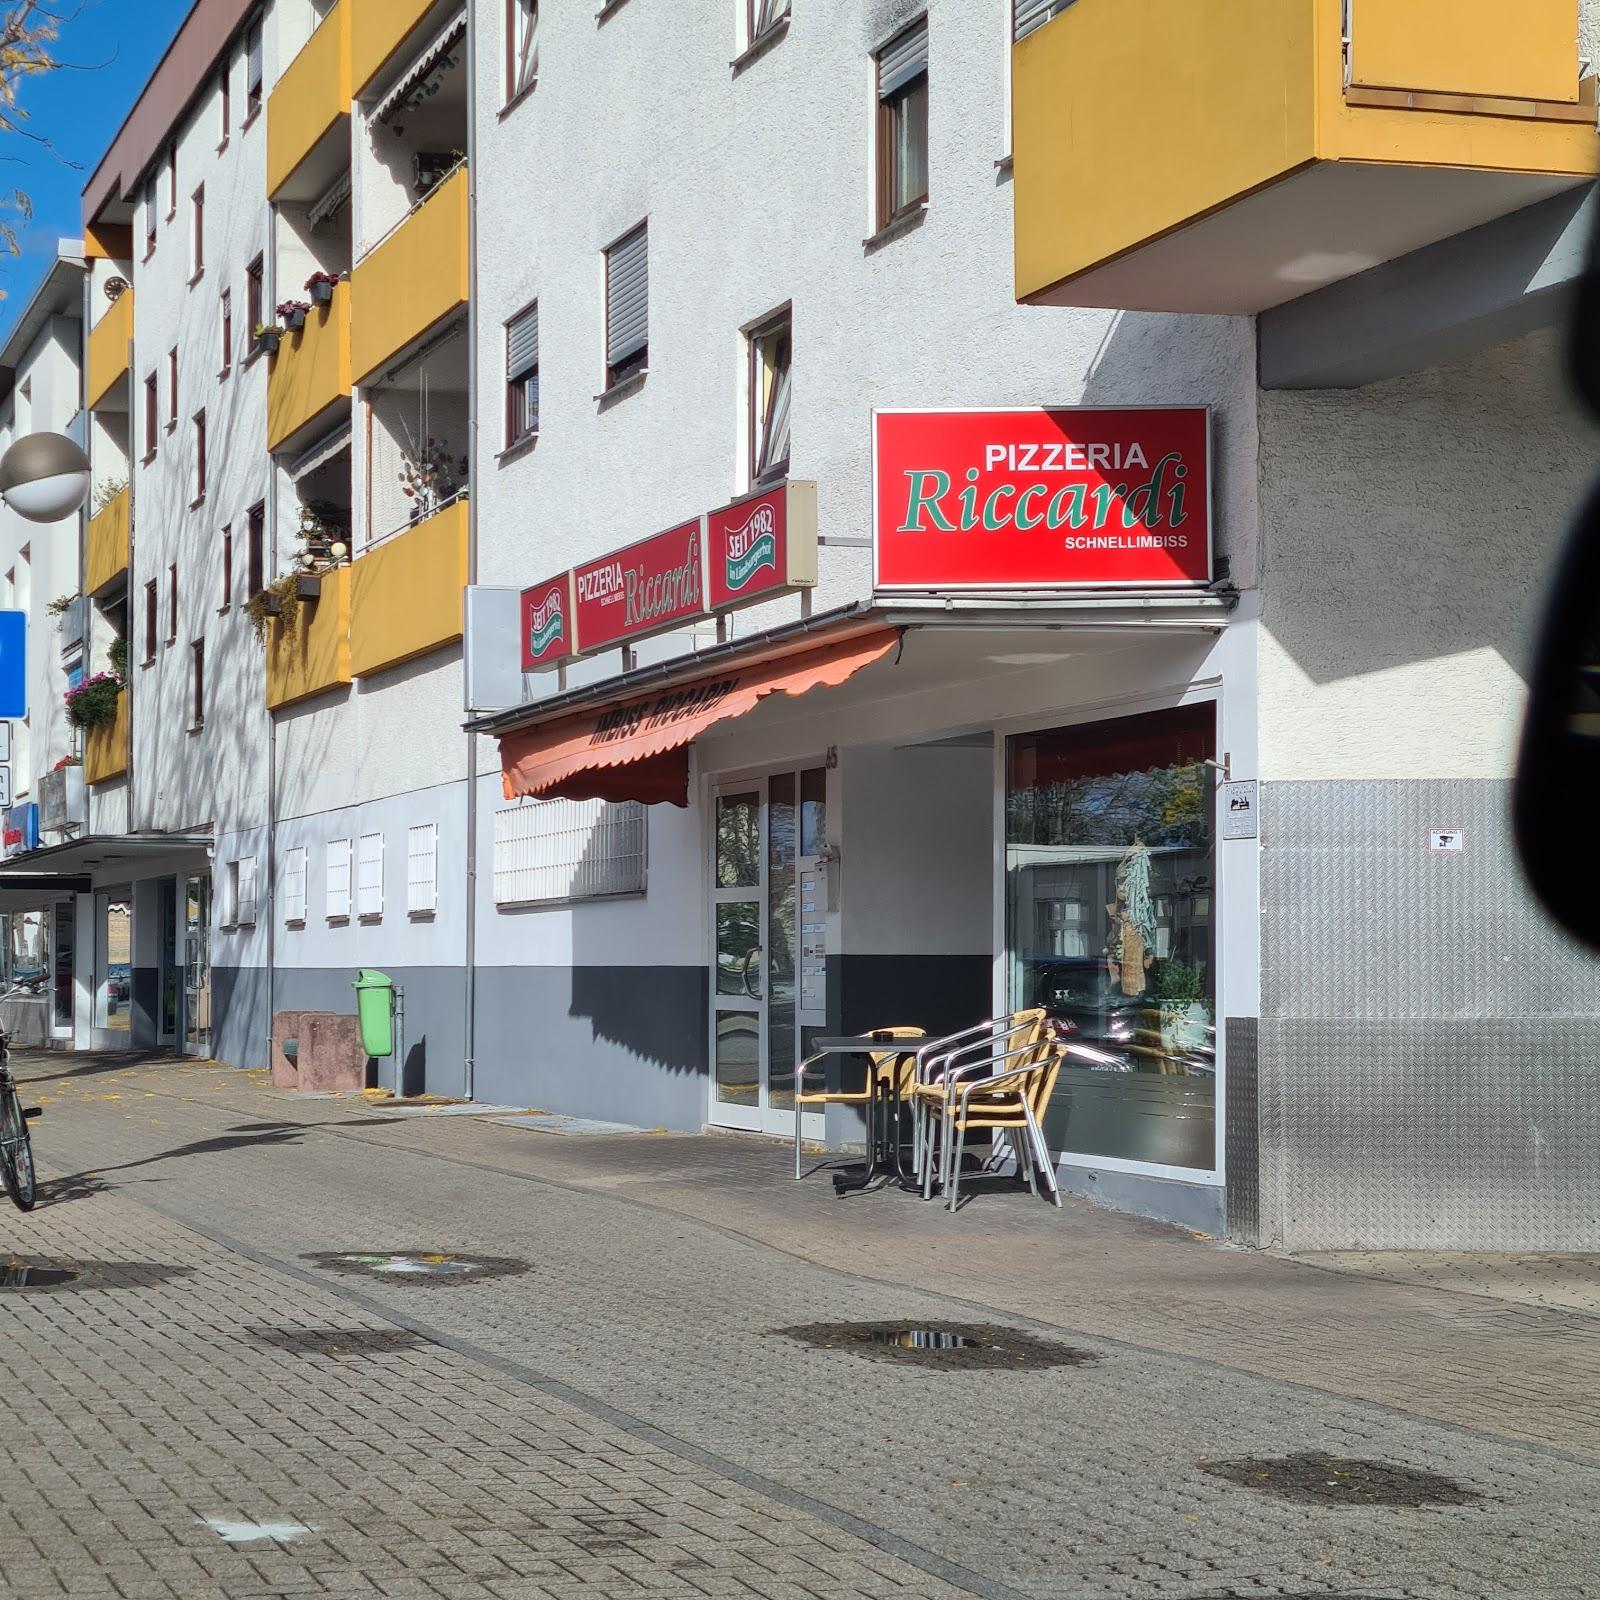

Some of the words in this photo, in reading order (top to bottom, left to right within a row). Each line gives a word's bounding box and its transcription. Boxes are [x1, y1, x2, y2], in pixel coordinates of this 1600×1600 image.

[985, 443, 1149, 472] PIZZERIA
[896, 452, 1188, 533] Riccardi
[729, 526, 749, 558] SEIT
[749, 509, 773, 542] 1982
[1064, 535, 1188, 550] SCHNELLIMBISS
[577, 562, 624, 603] PIZZERIA
[623, 531, 700, 627] Riccardi
